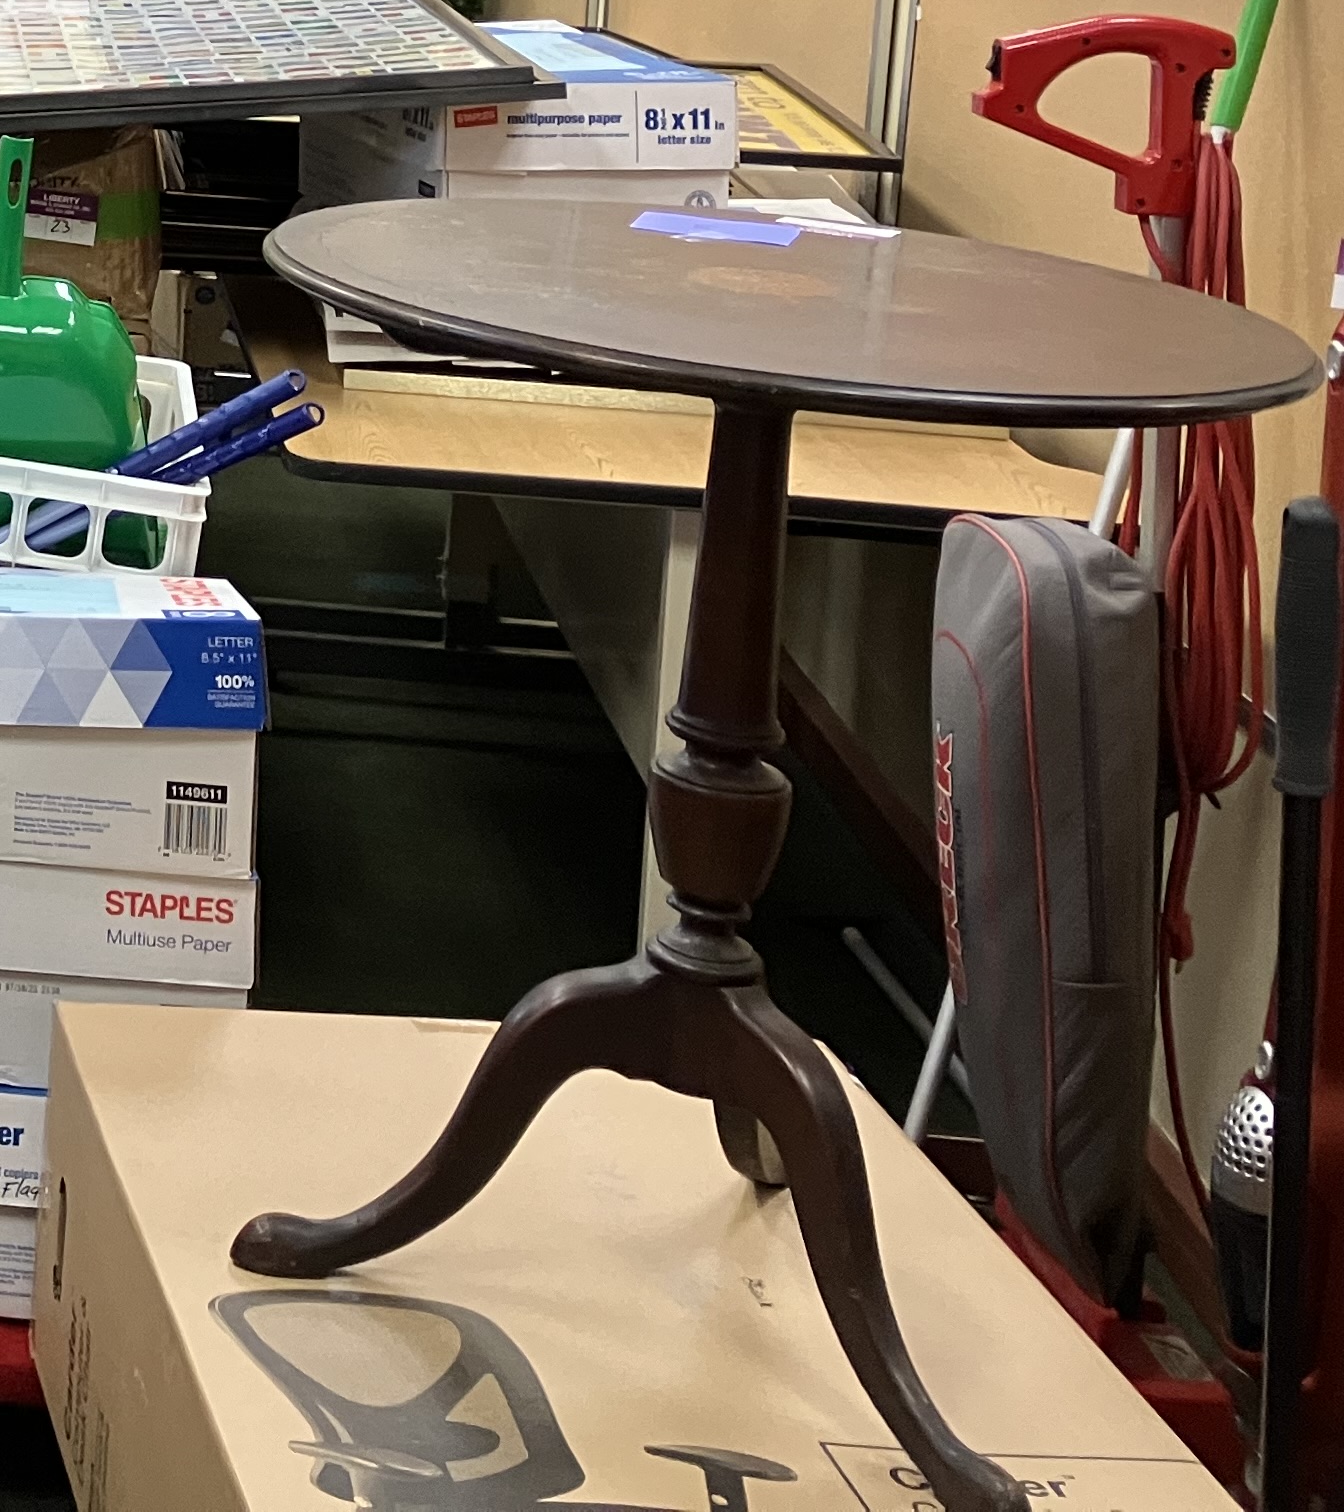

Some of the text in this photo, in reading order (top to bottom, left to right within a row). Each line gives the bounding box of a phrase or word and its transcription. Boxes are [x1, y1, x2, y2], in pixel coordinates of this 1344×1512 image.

[507, 113, 585, 126] multipurpose
[588, 114, 622, 126] paper
[672, 113, 685, 130] x
[688, 108, 710, 130] 11
[657, 134, 712, 145] letter size
[43, 193, 81, 205] LIBERTY
[50, 219, 71, 233] 23
[208, 636, 254, 648] LETTER
[215, 674, 255, 689] 100%
[105, 890, 234, 924] STAPLES
[107, 929, 232, 954] Multiuse Paper
[3, 1168, 39, 1180] copiers
